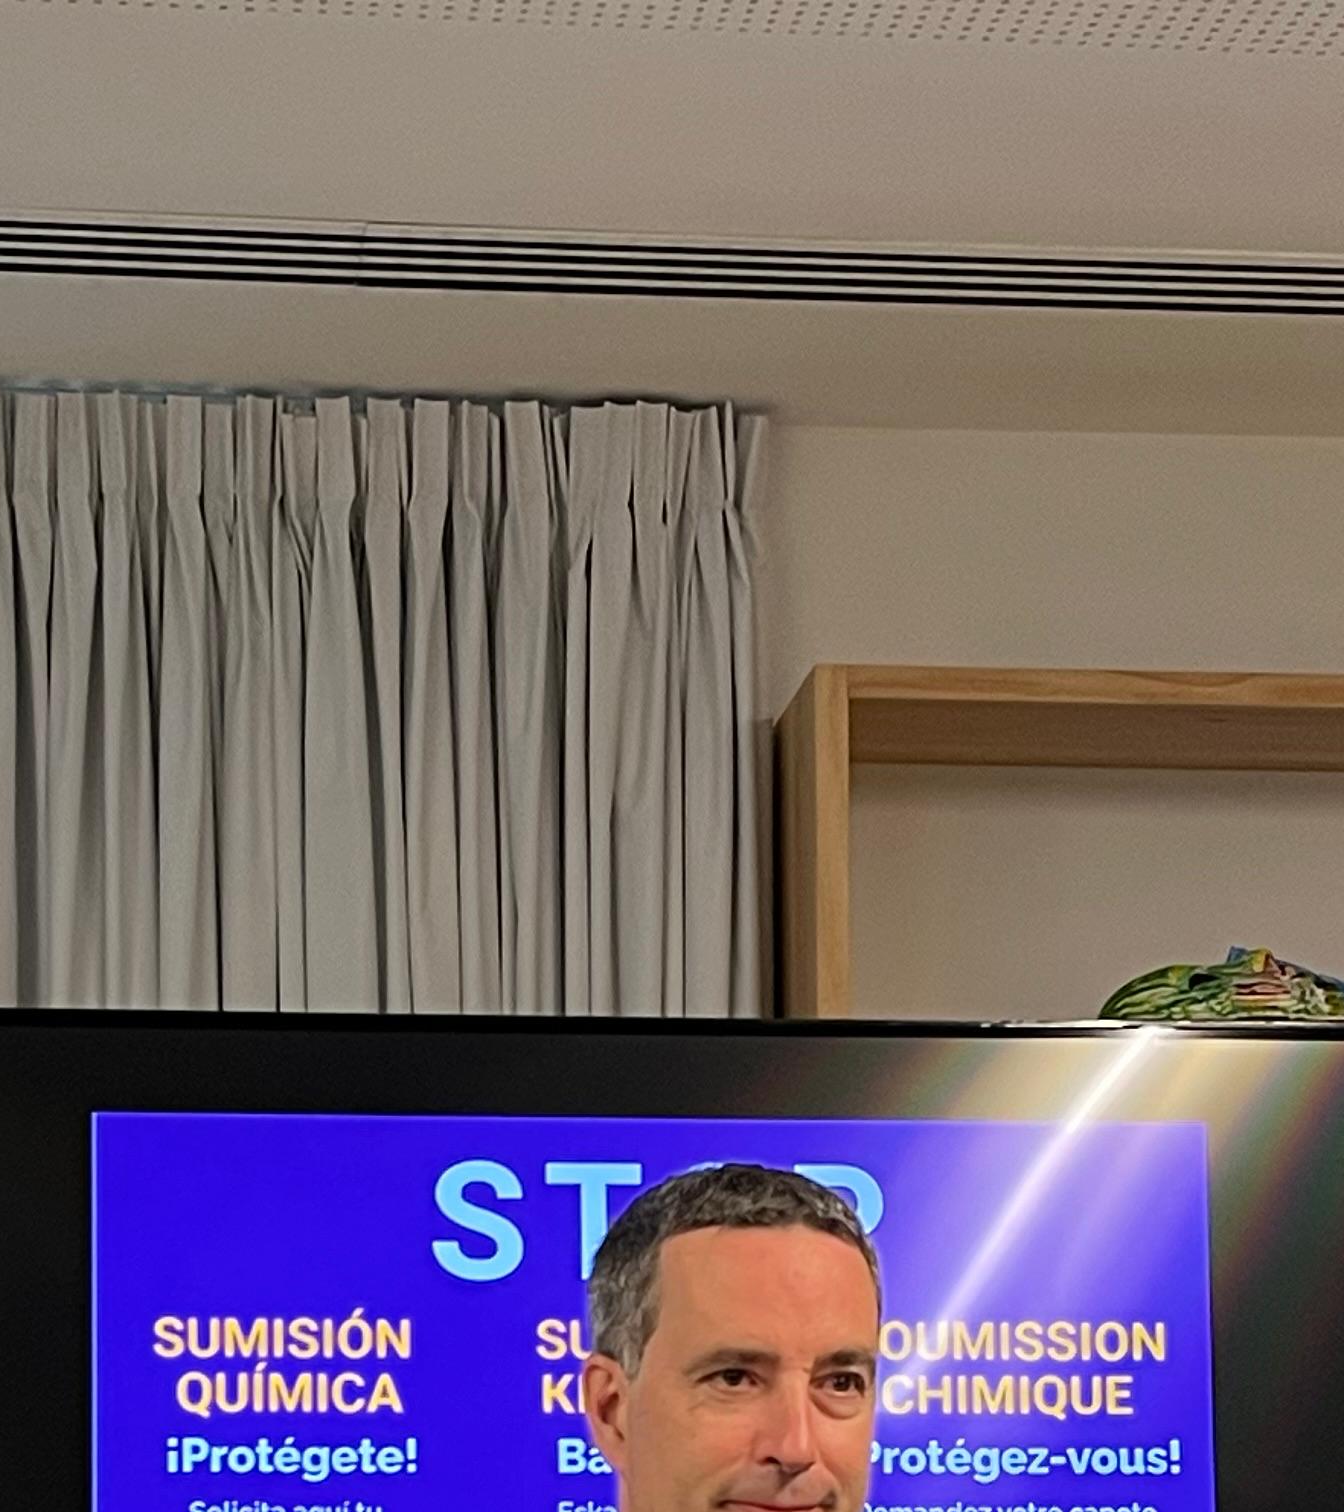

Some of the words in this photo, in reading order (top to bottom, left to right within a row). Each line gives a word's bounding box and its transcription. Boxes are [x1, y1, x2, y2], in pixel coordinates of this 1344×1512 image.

[153, 1308, 411, 1359] SUMISIÓN
[176, 1361, 404, 1418] QUÍMICA
[882, 1373, 1134, 1420] CHIMIQUE
[166, 1437, 418, 1482] ¡Protégete!
